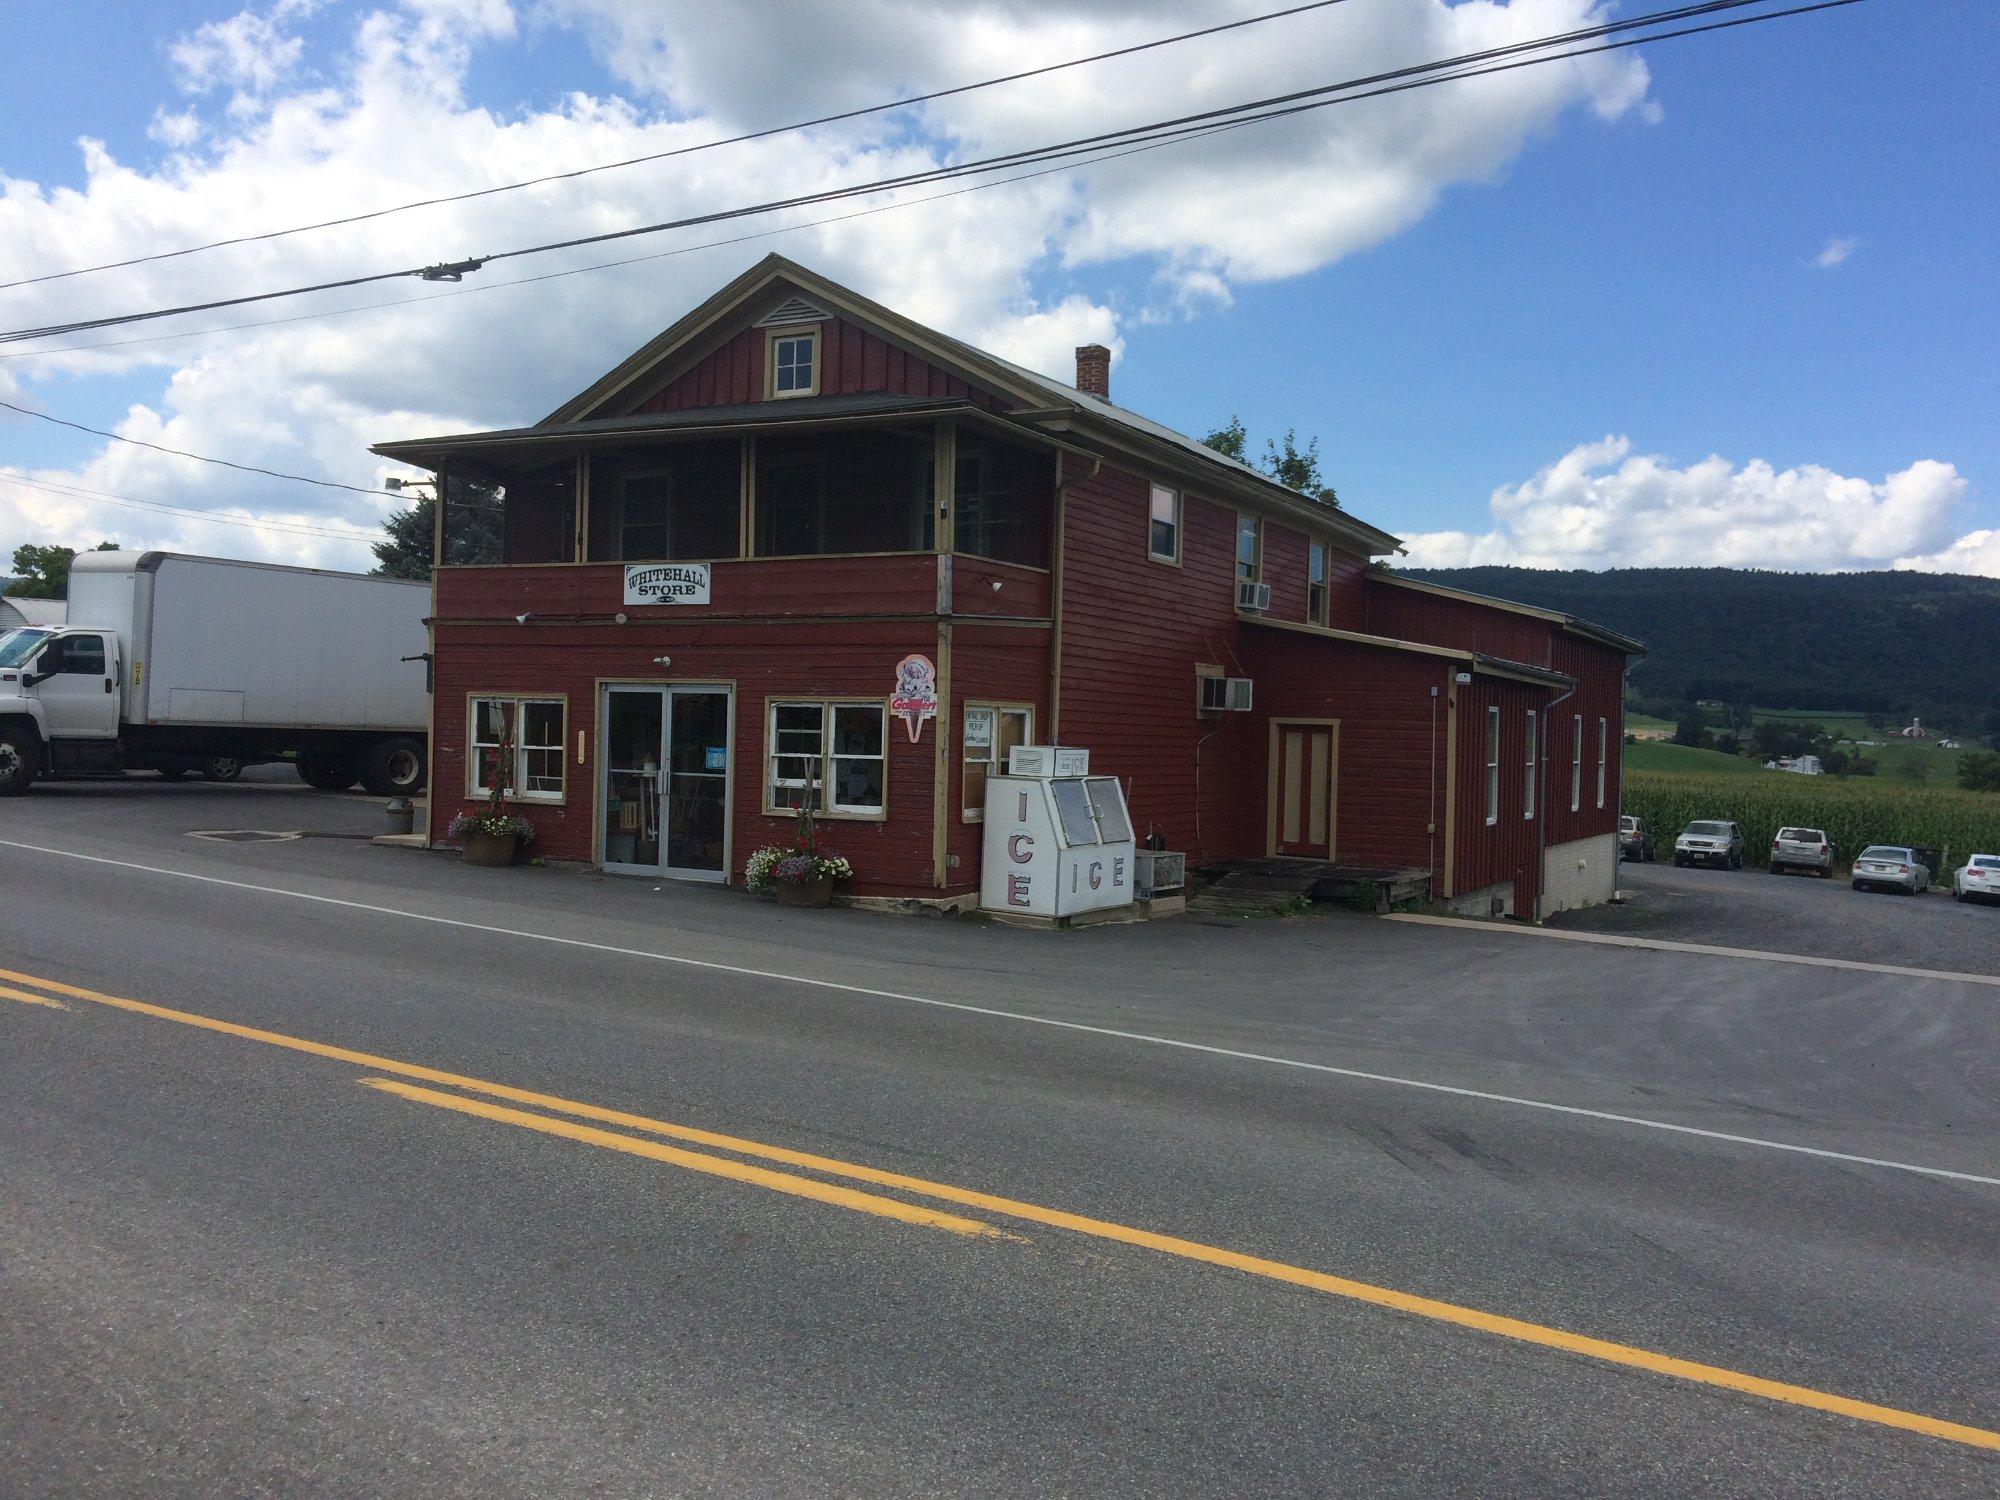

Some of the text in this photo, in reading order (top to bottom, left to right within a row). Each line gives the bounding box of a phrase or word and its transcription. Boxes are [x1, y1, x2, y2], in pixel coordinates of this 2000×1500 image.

[628, 567, 706, 590] WHITEHALL
[638, 584, 696, 596] STORE
[1007, 788, 1035, 907] ICE
[1071, 853, 1125, 893] ICE
